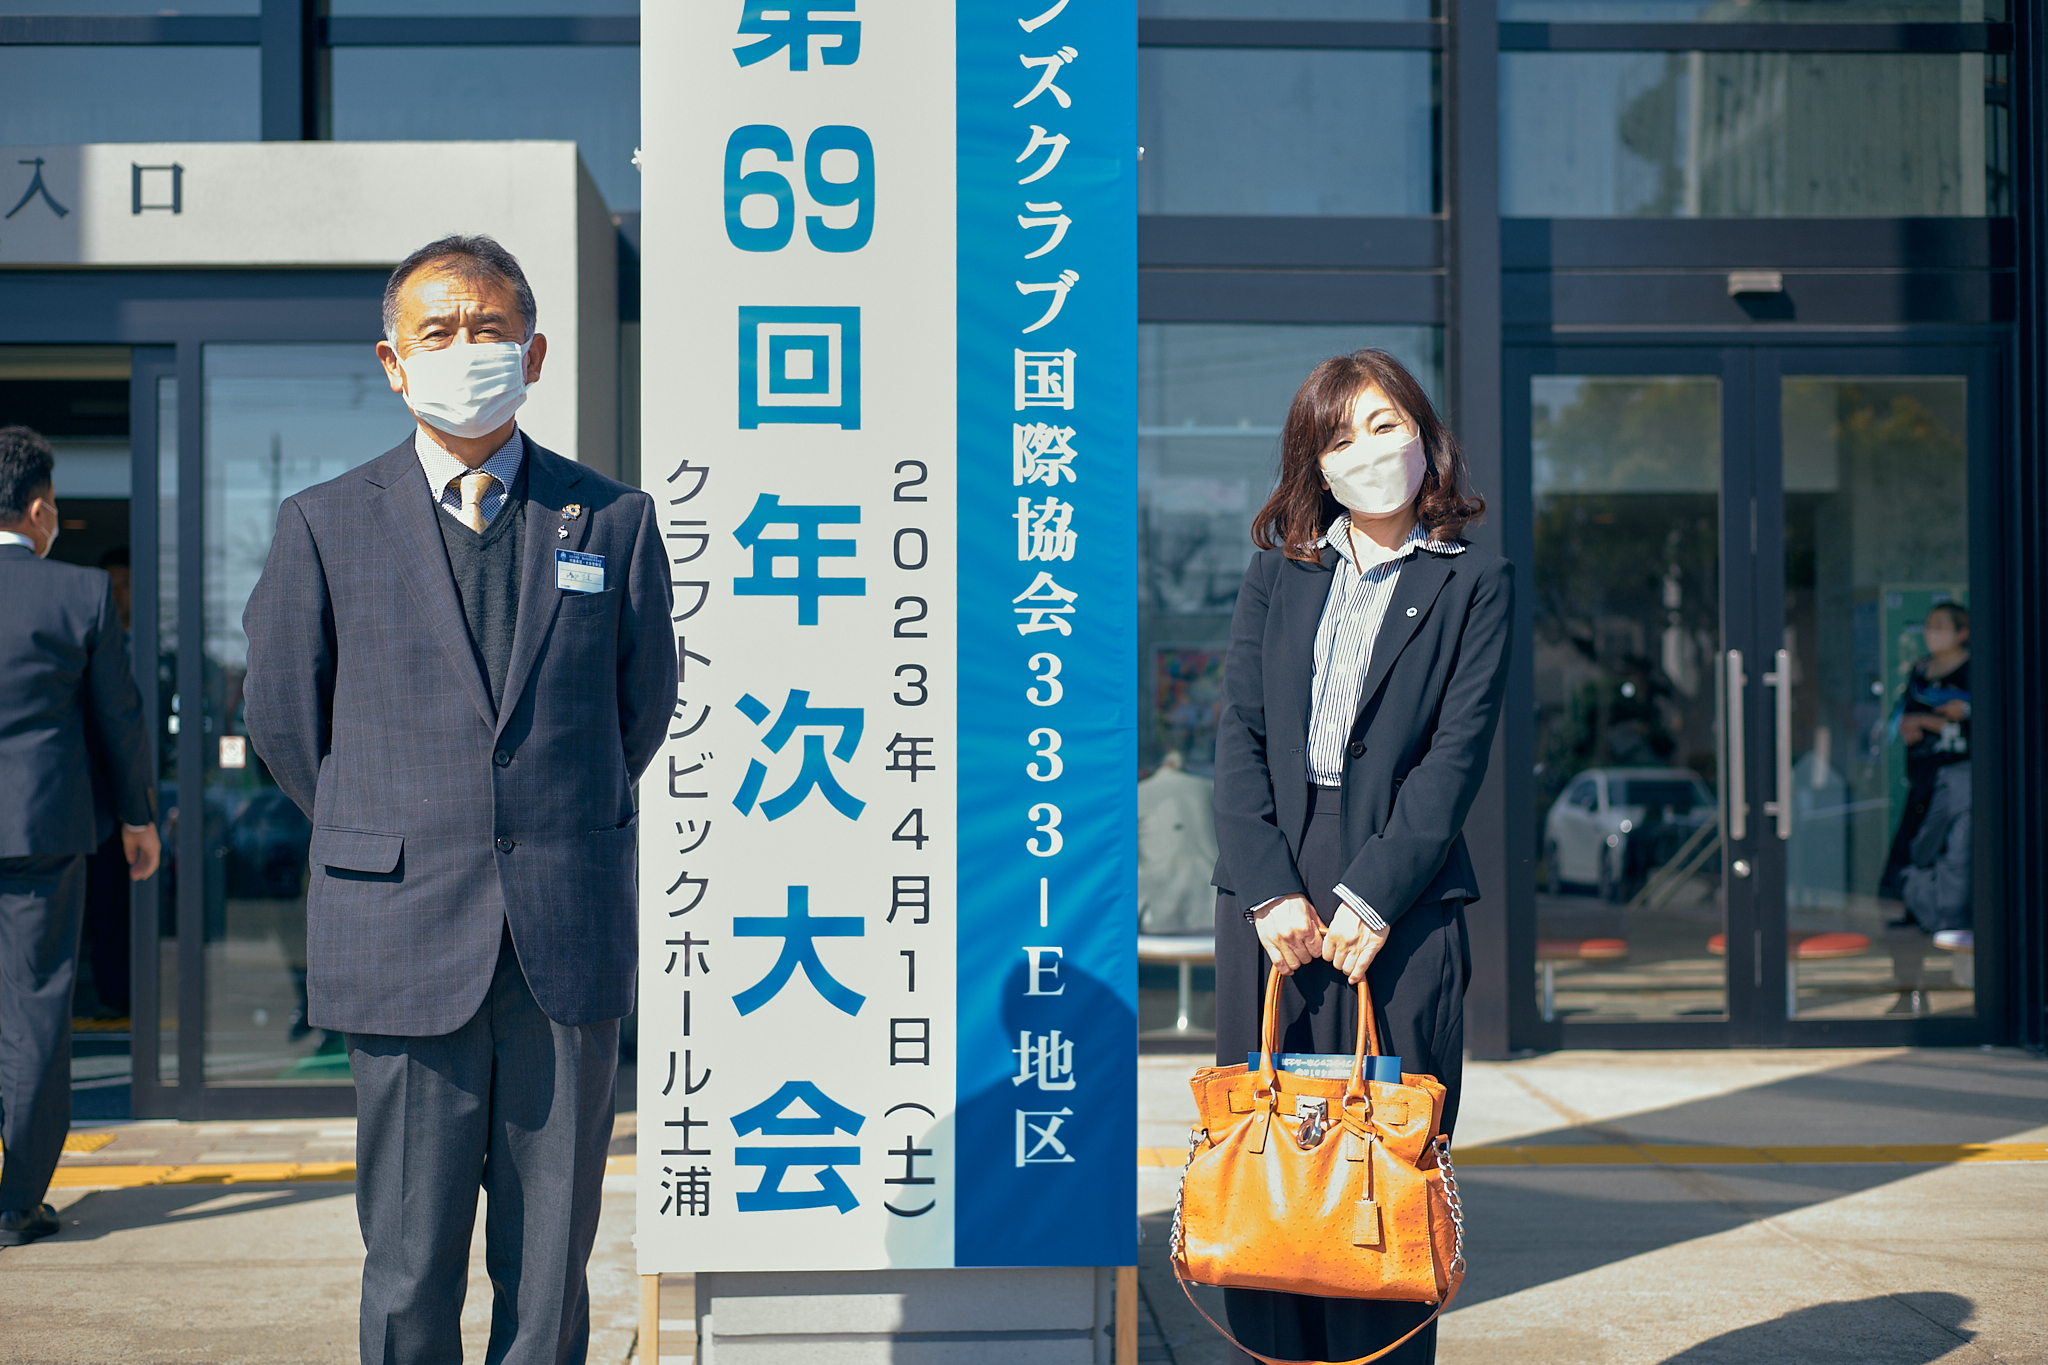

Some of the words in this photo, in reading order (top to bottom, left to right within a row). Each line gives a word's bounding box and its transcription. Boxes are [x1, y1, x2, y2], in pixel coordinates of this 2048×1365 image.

[5, 157, 184, 219] 入口
[660, 460, 714, 1217] クラフトシビックホール土浦
[724, 0, 875, 1214] 第69回年次大会
[884, 460, 936, 1217] 2023年4月1日(土)
